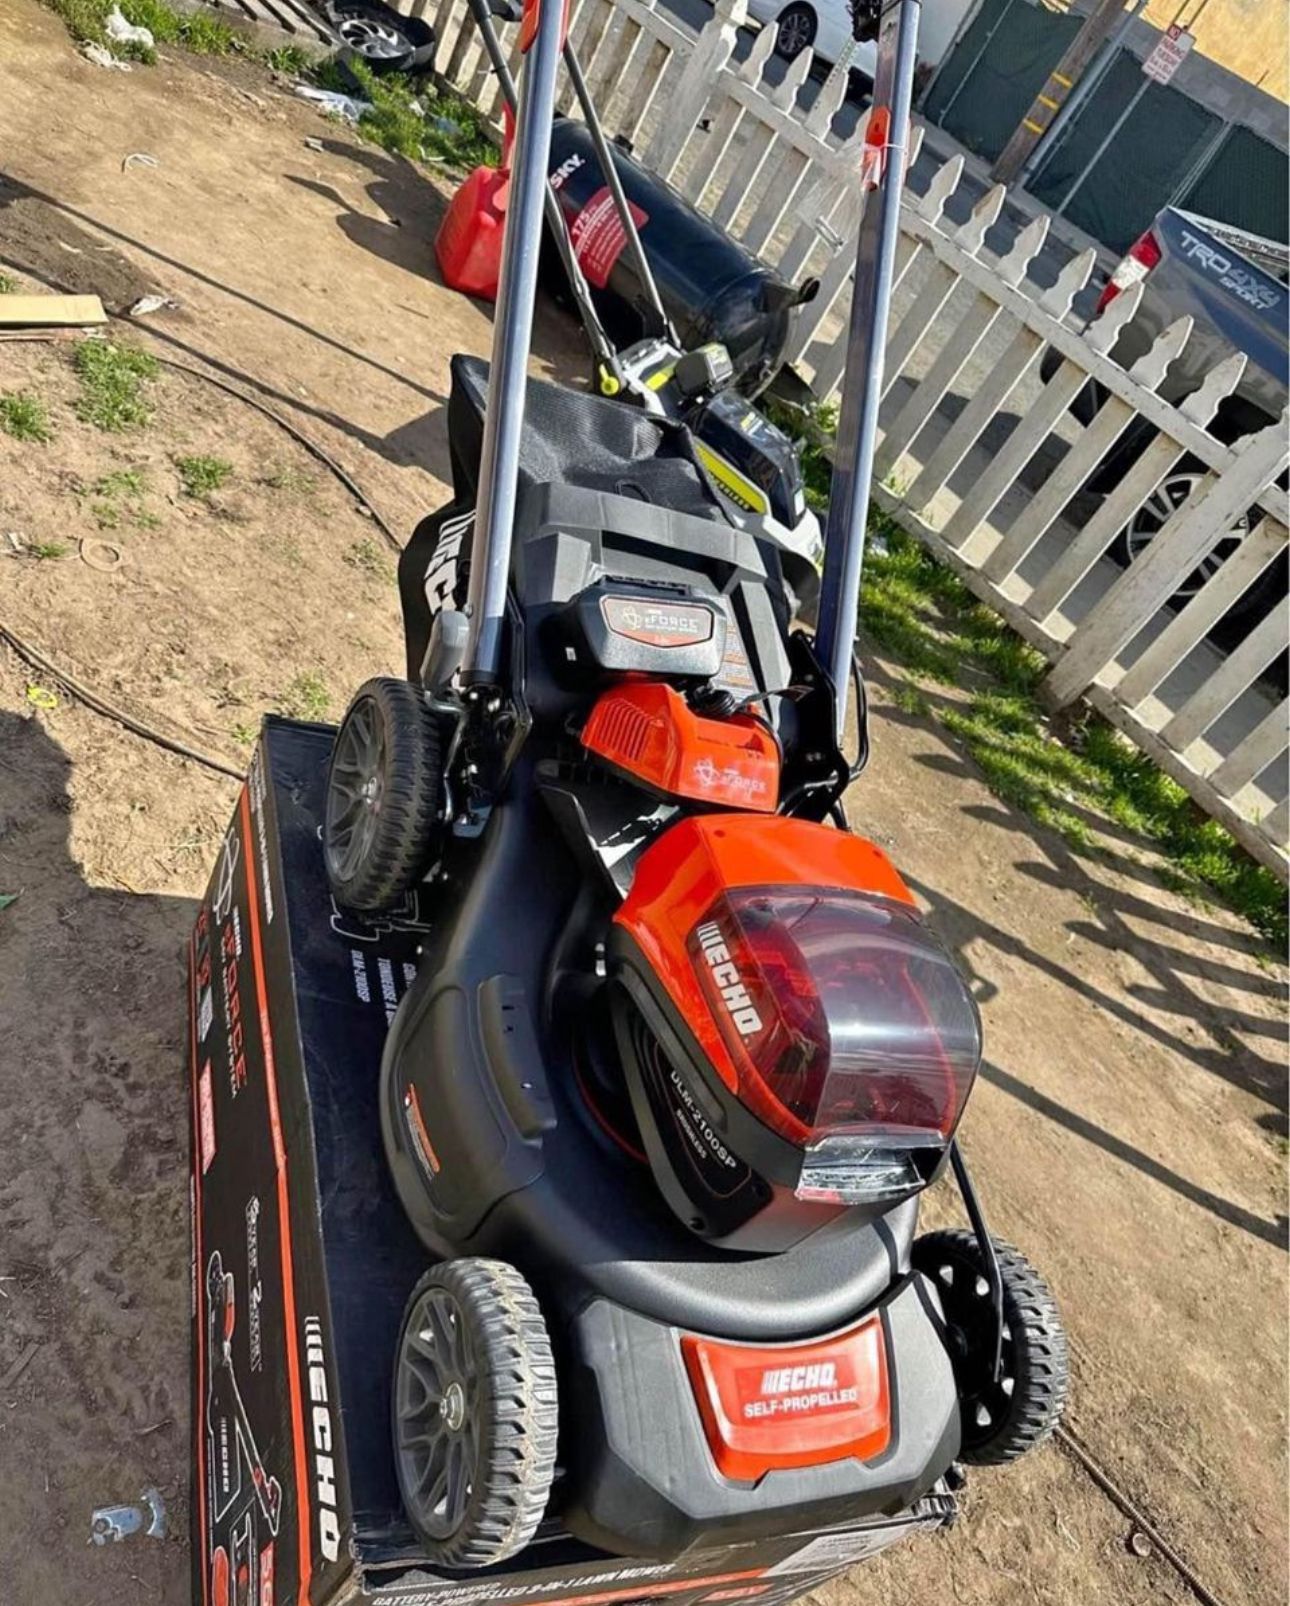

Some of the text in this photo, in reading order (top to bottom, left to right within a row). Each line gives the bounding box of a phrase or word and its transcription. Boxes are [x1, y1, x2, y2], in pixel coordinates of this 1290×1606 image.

[550, 153, 581, 190] SKY
[1219, 276, 1269, 310] SPORT
[703, 942, 763, 1035] ECHO
[775, 1363, 836, 1394] ECHO
[744, 1387, 858, 1419] SELF-PROPELLED
[309, 1365, 341, 1563] ECHO
[372, 1582, 501, 1606] BATTERY-POWERED
[526, 1578, 576, 1595] 3-IN-1
[572, 1570, 621, 1587] LAWN
[616, 1563, 677, 1581] MOWER
